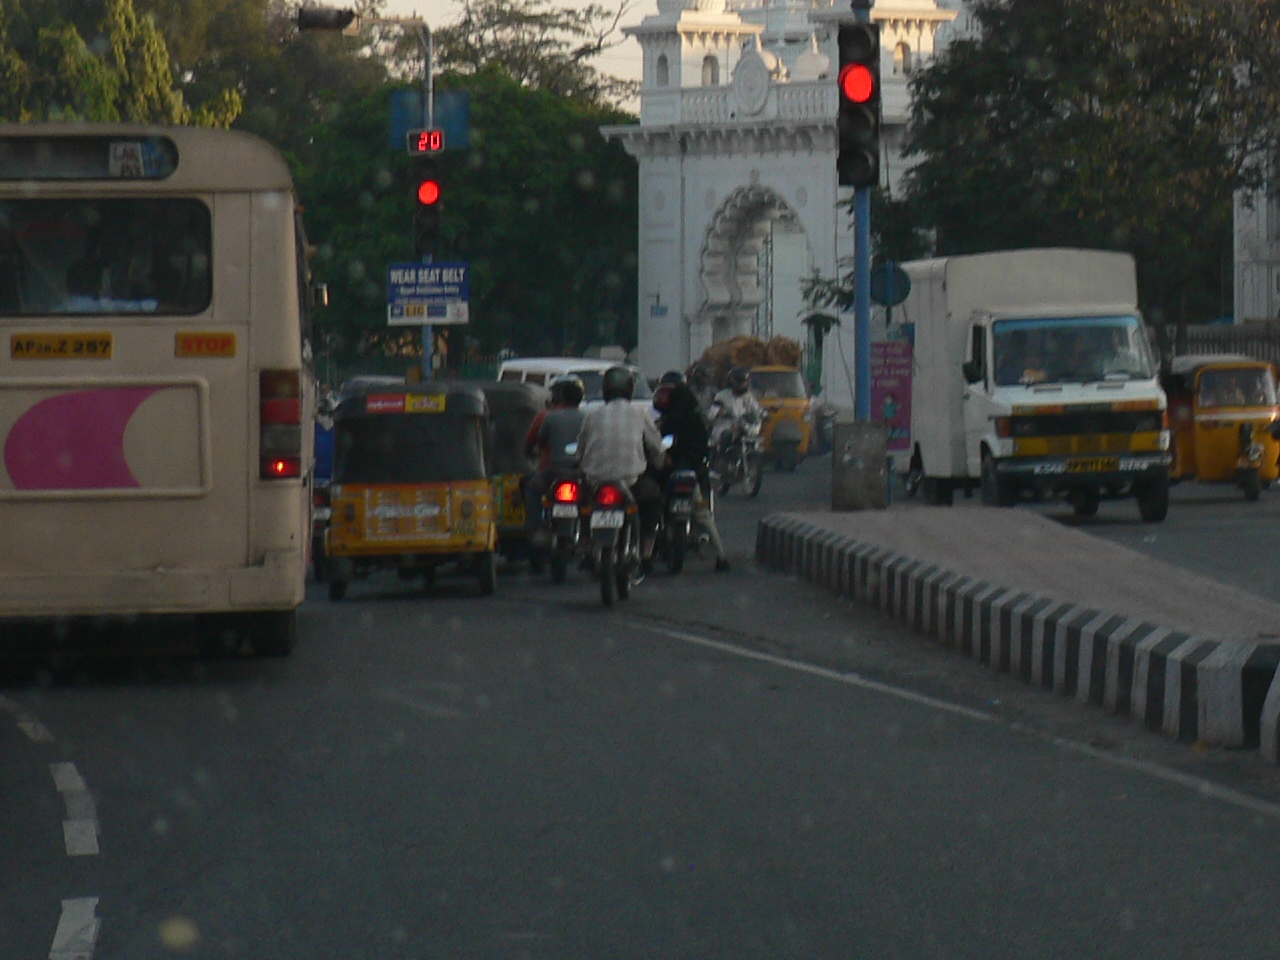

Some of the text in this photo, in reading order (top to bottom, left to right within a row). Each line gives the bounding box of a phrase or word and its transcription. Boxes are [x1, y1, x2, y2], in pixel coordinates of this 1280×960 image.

[418, 130, 441, 151] 20
[390, 267, 466, 284] WEAR SEAT BELT
[181, 337, 233, 352] STOP
